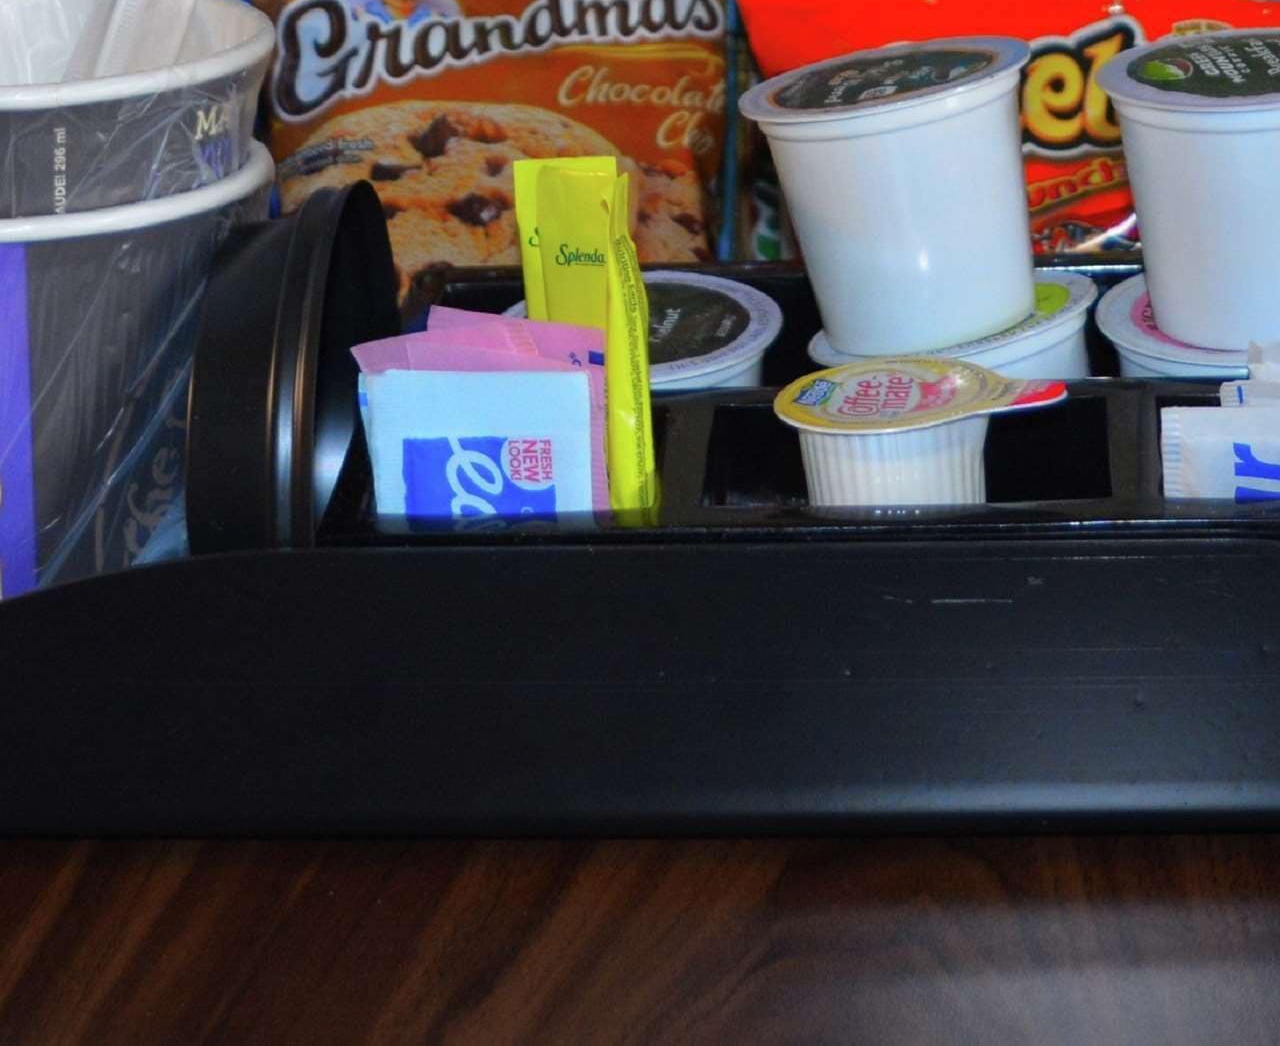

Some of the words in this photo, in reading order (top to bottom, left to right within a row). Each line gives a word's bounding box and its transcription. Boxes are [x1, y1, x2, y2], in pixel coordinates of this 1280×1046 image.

[53, 127, 66, 144] ml
[54, 147, 66, 171] 296
[555, 243, 607, 267] Splenda
[881, 374, 914, 411] mate
[508, 440, 522, 481] LOOK!
[521, 439, 540, 483] NEW
[539, 440, 553, 481] FRESH
